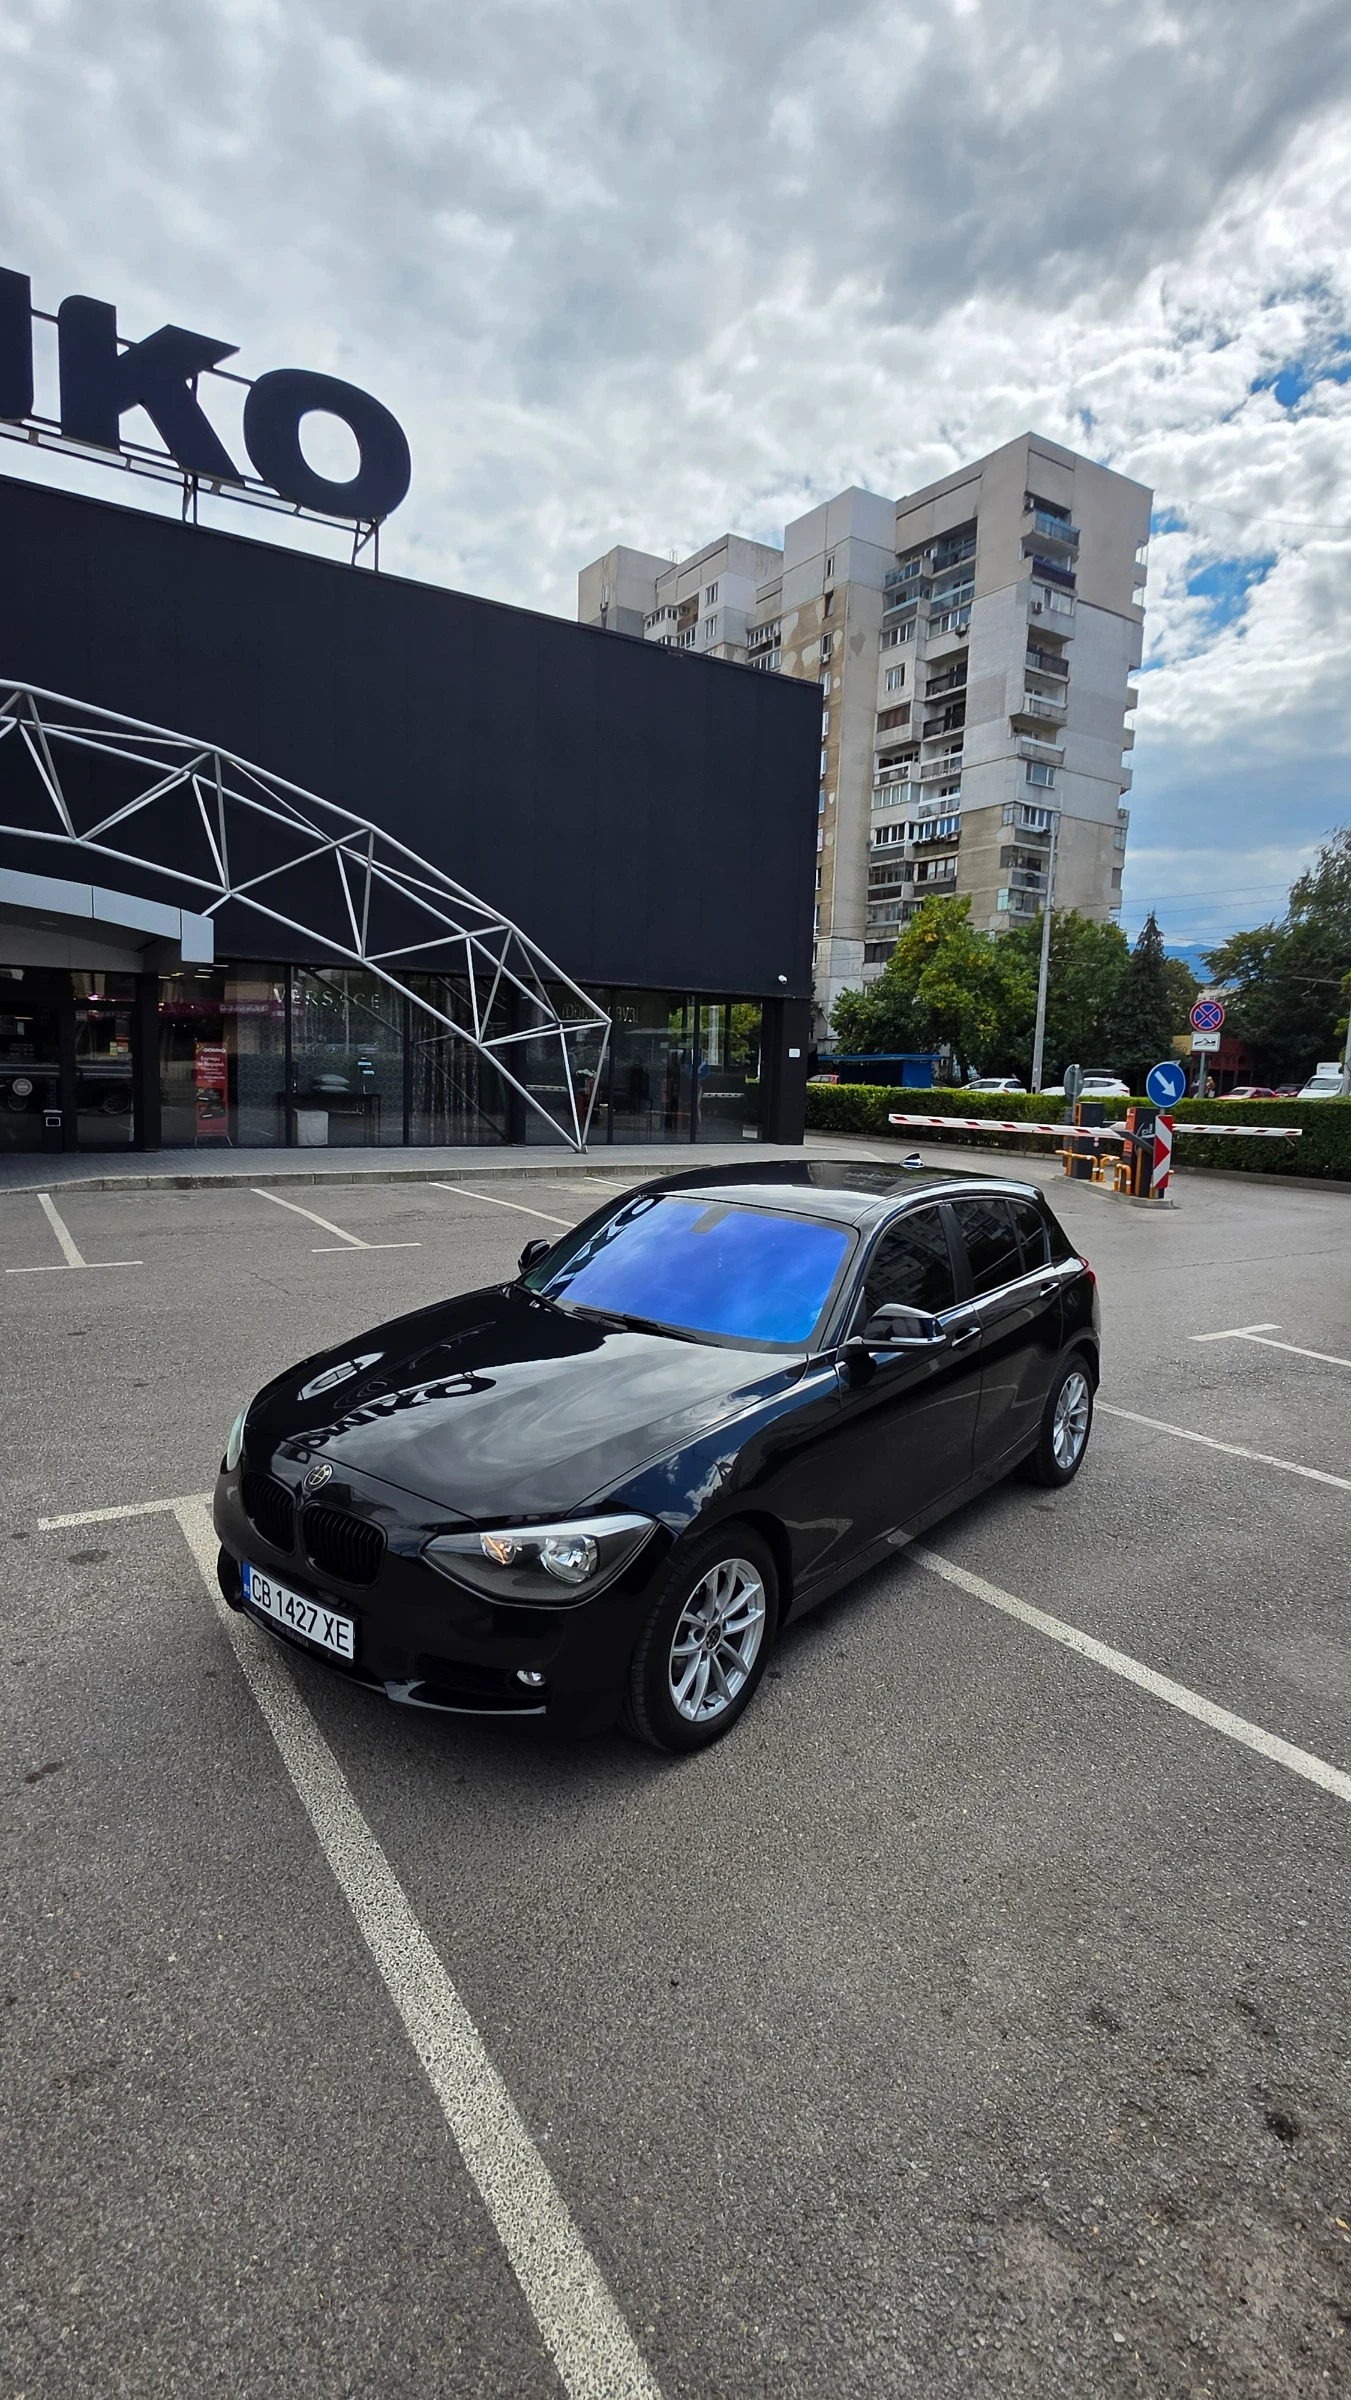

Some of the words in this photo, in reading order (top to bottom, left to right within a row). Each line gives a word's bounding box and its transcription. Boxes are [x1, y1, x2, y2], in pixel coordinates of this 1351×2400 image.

[252, 1574, 272, 1609] CB
[276, 1590, 318, 1634] 1427
[323, 1613, 350, 1653] XE
